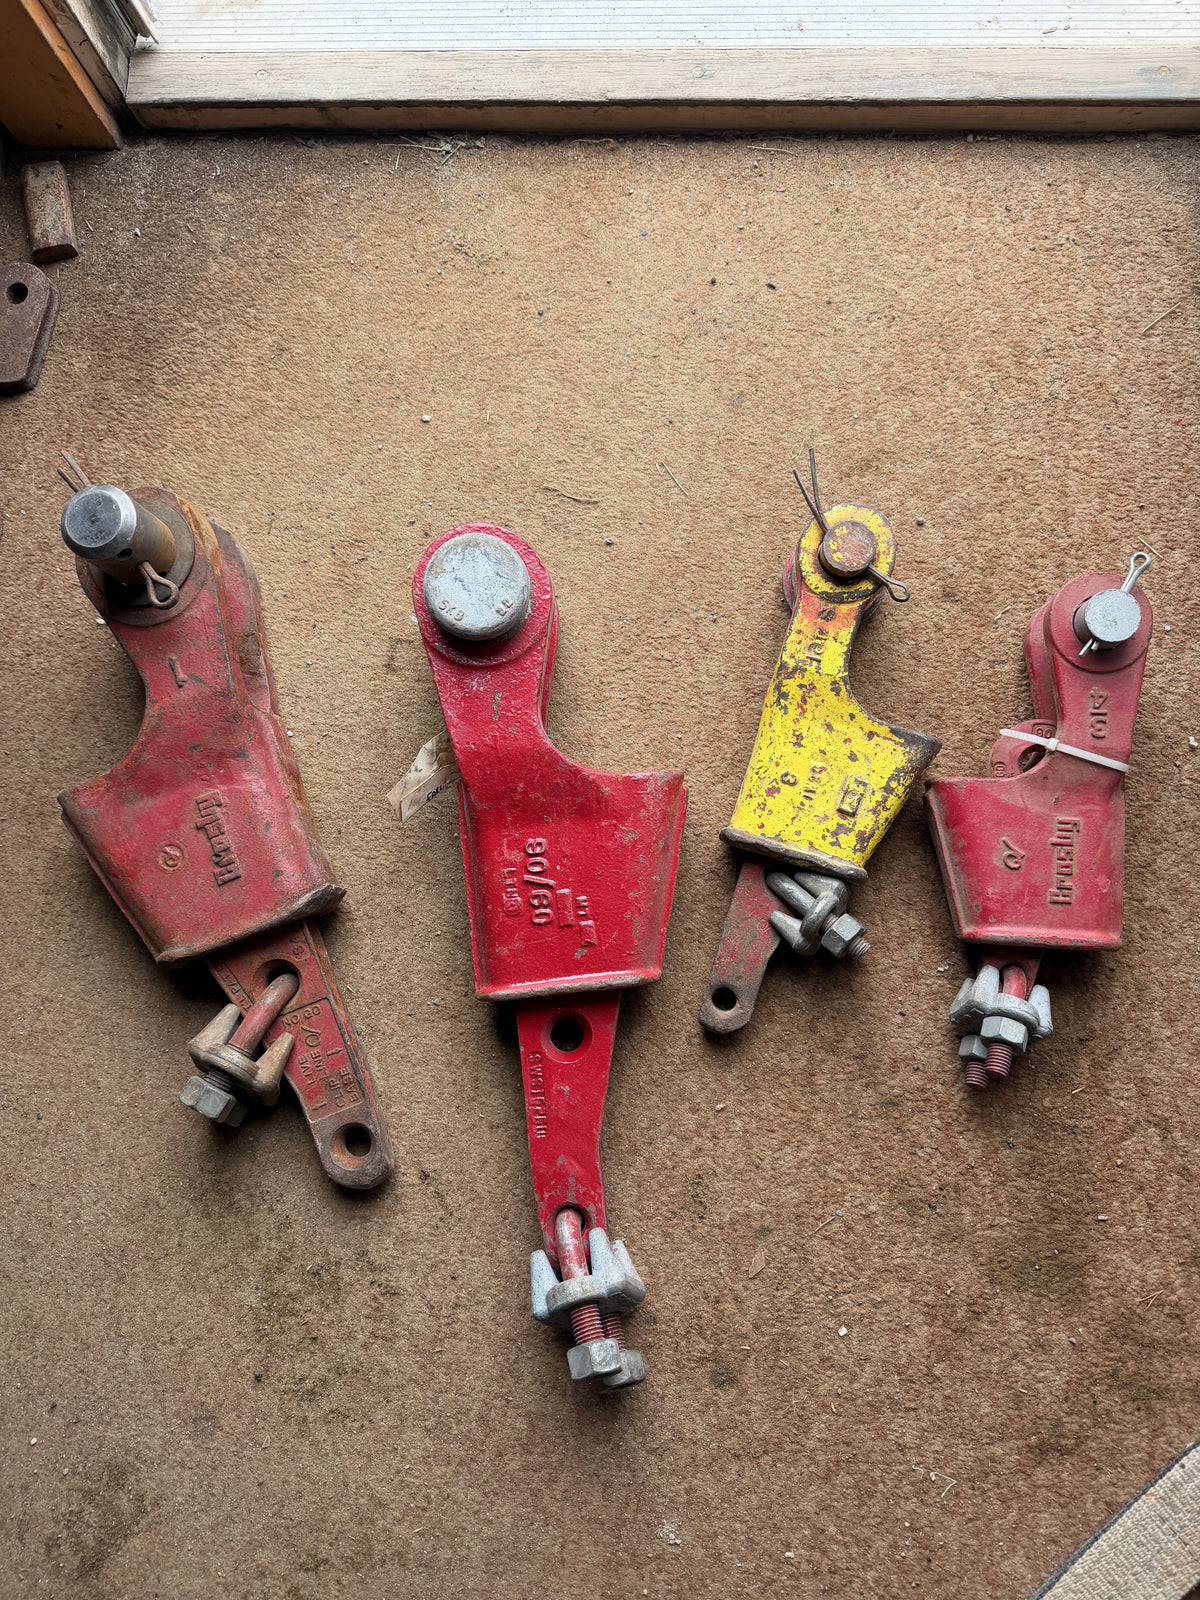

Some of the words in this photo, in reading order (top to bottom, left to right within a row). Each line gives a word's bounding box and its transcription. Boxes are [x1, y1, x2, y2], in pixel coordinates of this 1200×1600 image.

[1049, 818, 1081, 905] Crosby
[282, 1014, 300, 1029] NO
[304, 1005, 321, 1019] GO
[298, 1054, 316, 1086] LIVE
[311, 1050, 329, 1081] LINE
[329, 1079, 346, 1108] CLIP
[340, 1066, 358, 1103] BASE
